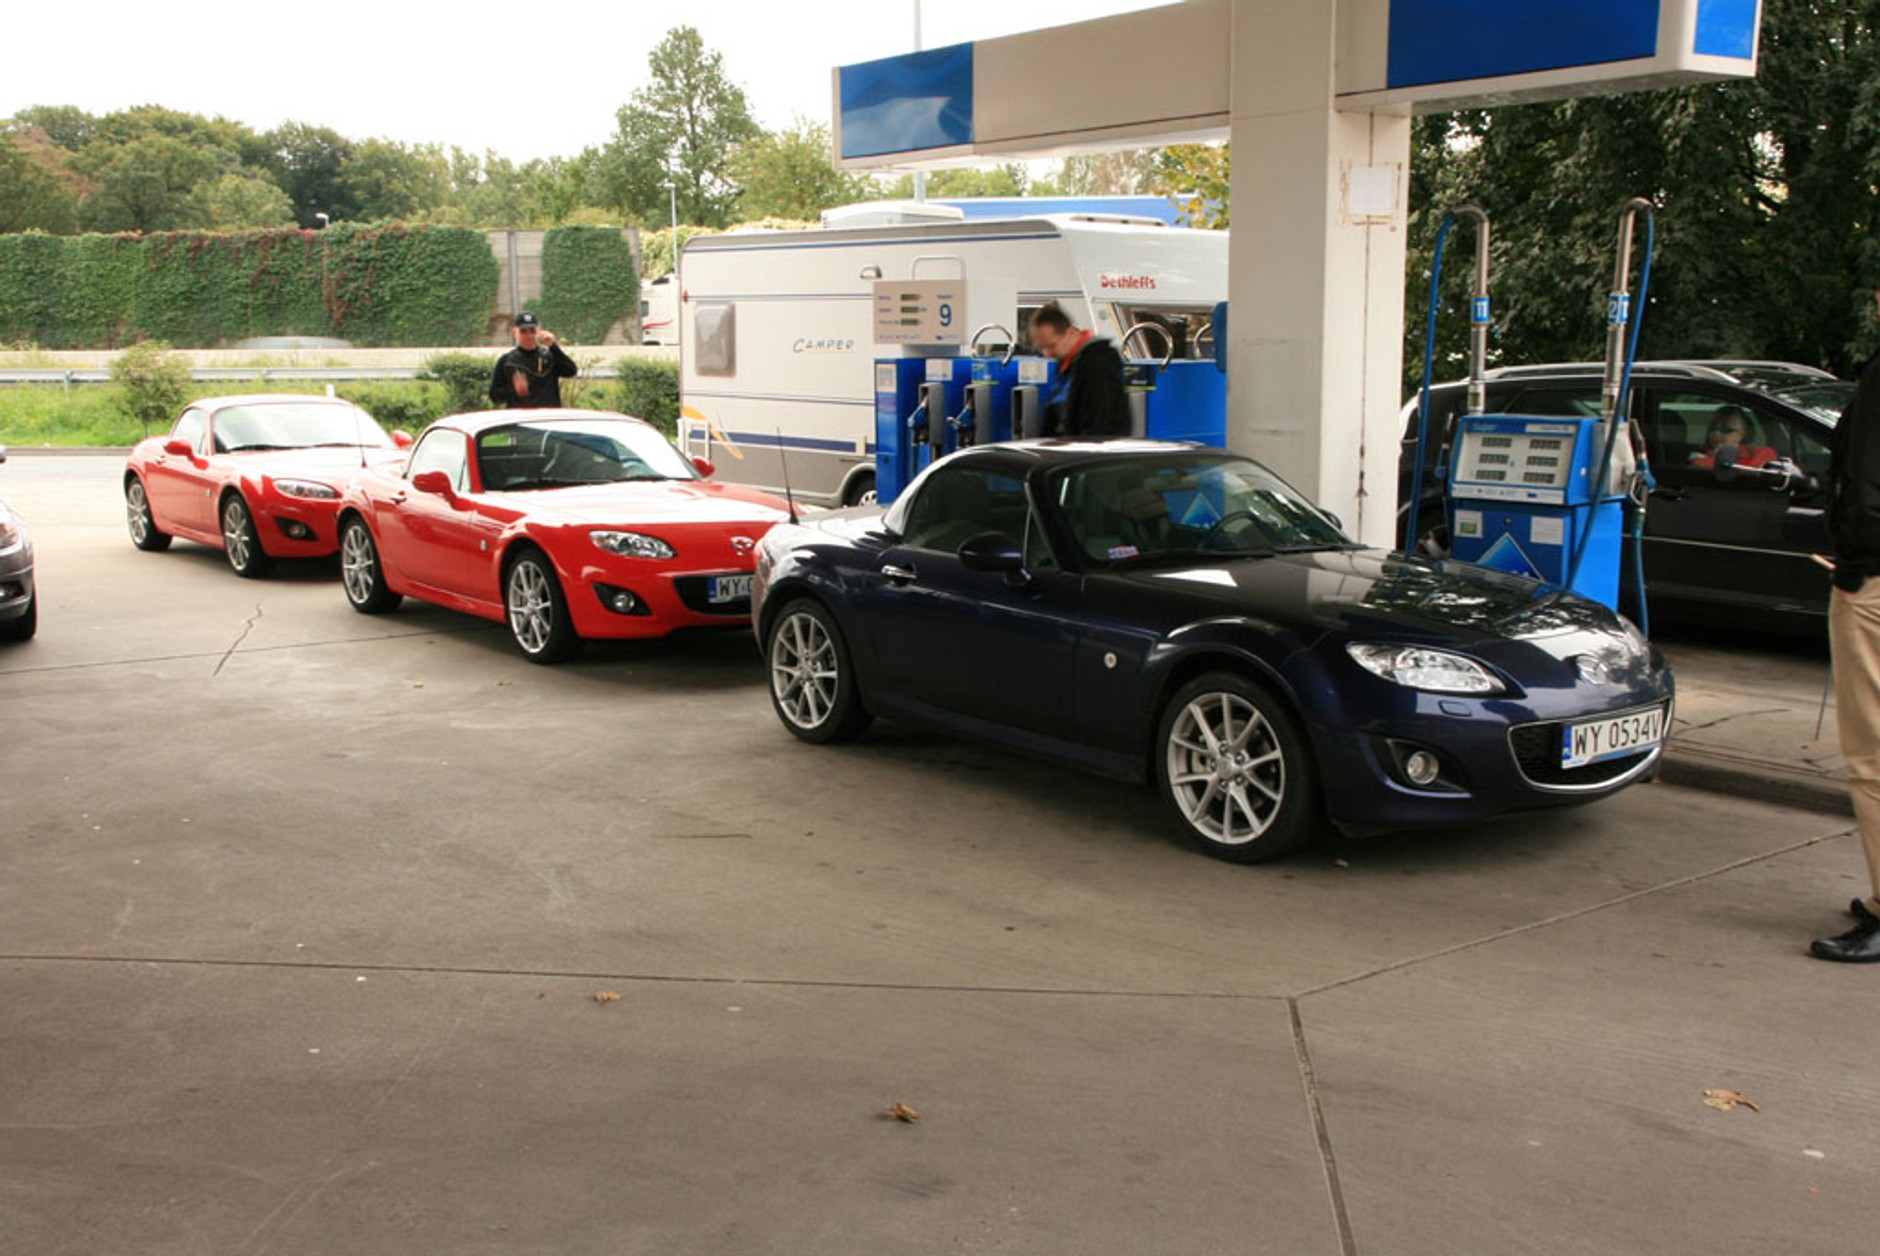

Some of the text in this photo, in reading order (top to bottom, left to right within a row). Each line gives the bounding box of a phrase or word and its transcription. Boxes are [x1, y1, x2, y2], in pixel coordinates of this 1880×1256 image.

[940, 303, 953, 328] 9
[1574, 713, 1661, 756] WY 0534V
